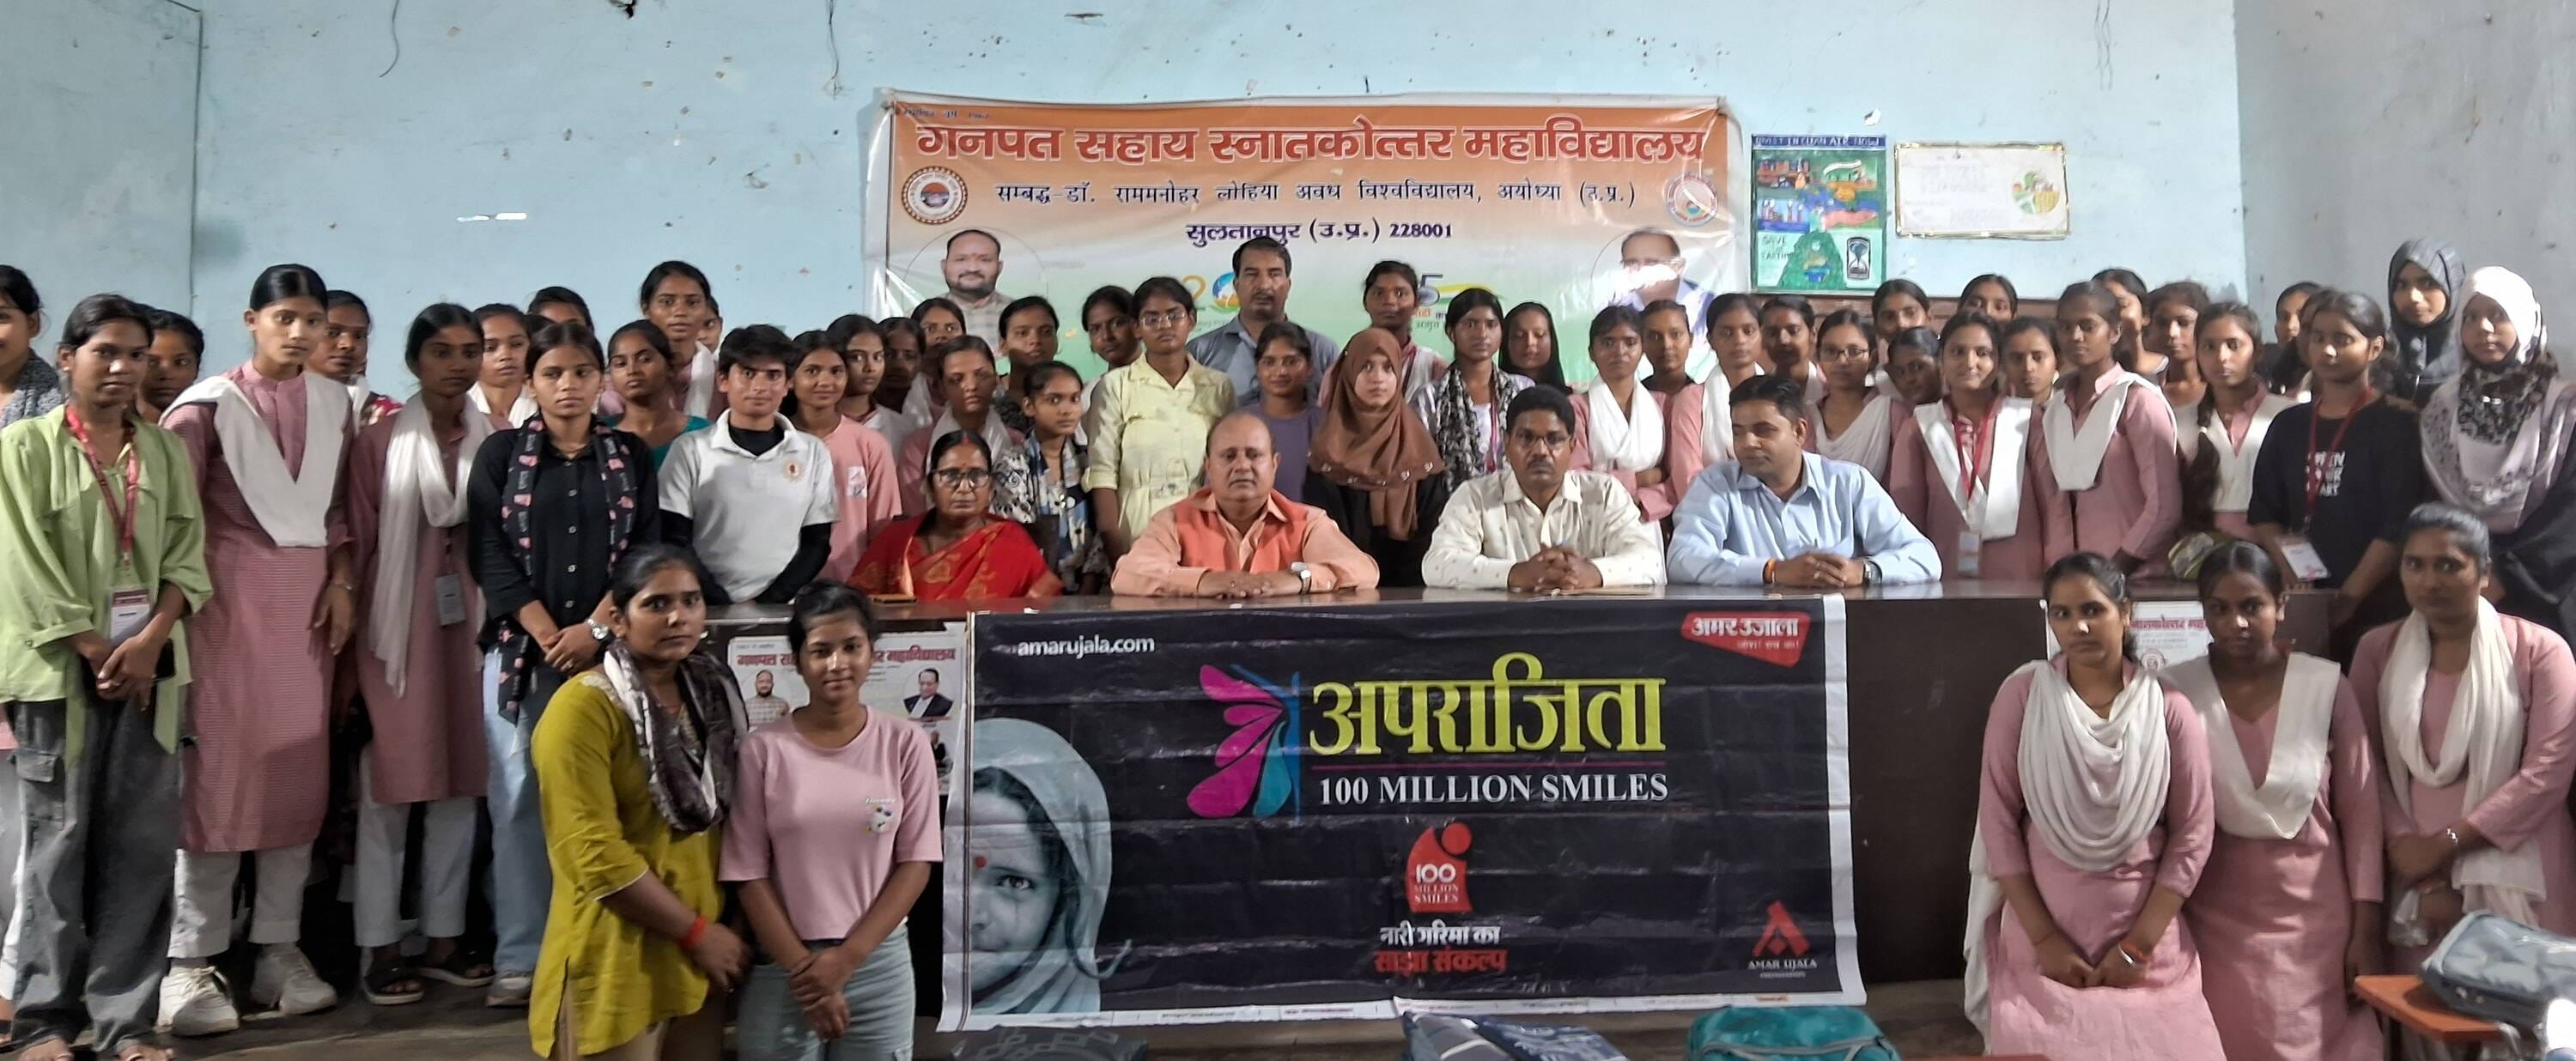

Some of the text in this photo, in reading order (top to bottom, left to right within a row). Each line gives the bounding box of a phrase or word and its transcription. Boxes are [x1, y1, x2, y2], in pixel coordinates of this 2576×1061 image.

[916, 113, 1707, 165] गनपत सहाय स्नातकोत्तर महाविद्यालय
[1114, 180, 1200, 203] राममनोहर
[1214, 180, 1279, 202] लोहिया
[1297, 182, 1341, 201] अवध
[1498, 178, 1561, 201] अयोध्या
[1389, 222, 1452, 239] 228001
[1691, 617, 1799, 637] अमर उजाला
[1018, 634, 1155, 659] amarujala.com
[1309, 652, 1667, 755] अपराजिता
[1321, 773, 1668, 805] 100 MILLION SMILES
[1415, 864, 1456, 883] 100
[1414, 884, 1459, 893] MILLION
[1414, 894, 1459, 904] SMILES
[1380, 919, 1501, 946] नारी गरिमा का
[1431, 943, 1508, 973] संकल्प
[1748, 958, 1818, 972] AMAR UJALA
